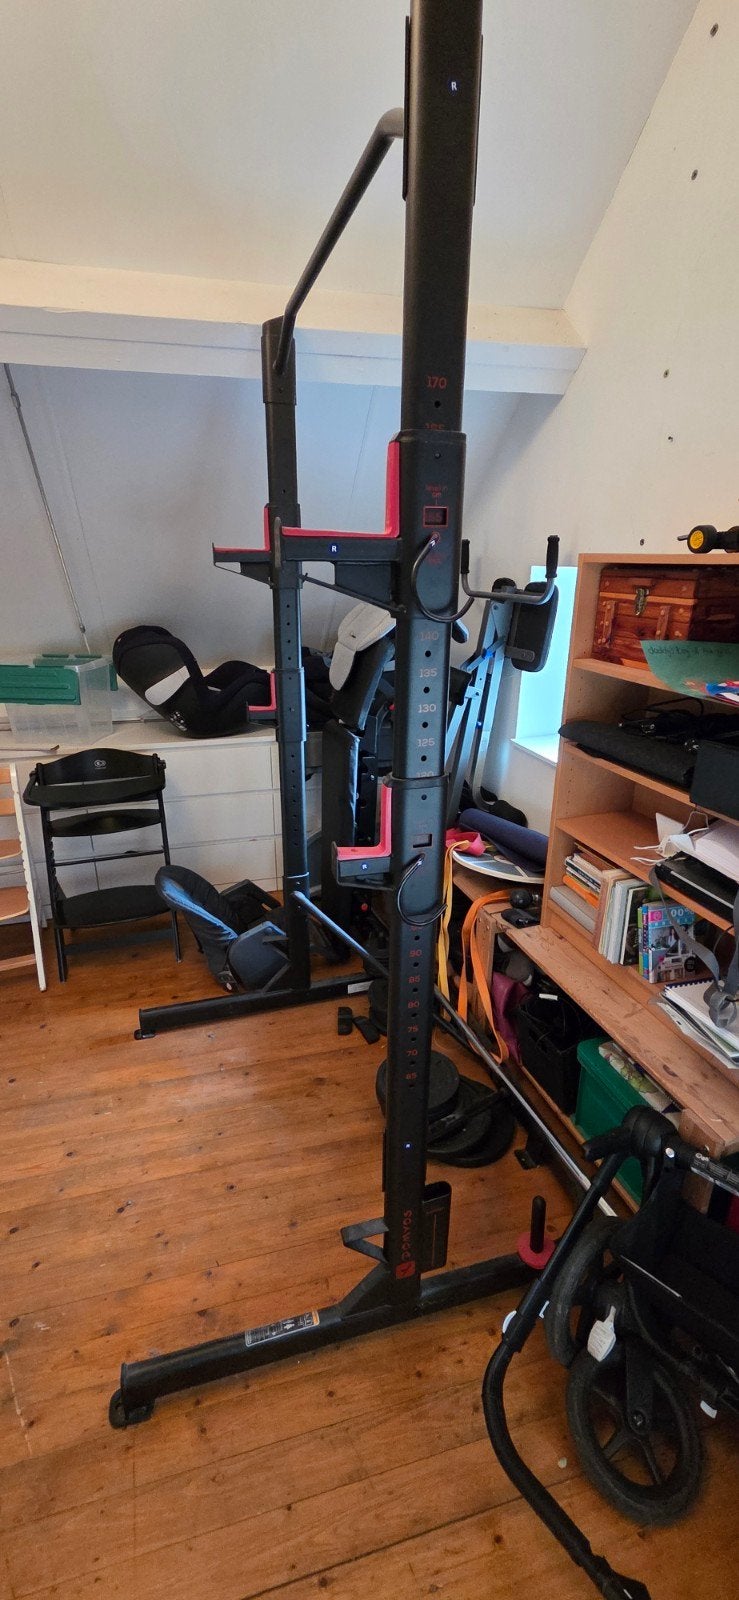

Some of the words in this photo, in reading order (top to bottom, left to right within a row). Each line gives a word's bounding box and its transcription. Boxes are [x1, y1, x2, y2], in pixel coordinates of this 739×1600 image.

[451, 81, 458, 91] R
[426, 375, 448, 389] 170
[419, 667, 438, 678] 135
[418, 703, 437, 713] 130
[417, 737, 436, 747] 125
[409, 949, 423, 957] 90
[407, 1001, 420, 1009] 80
[407, 1024, 419, 1032] 75
